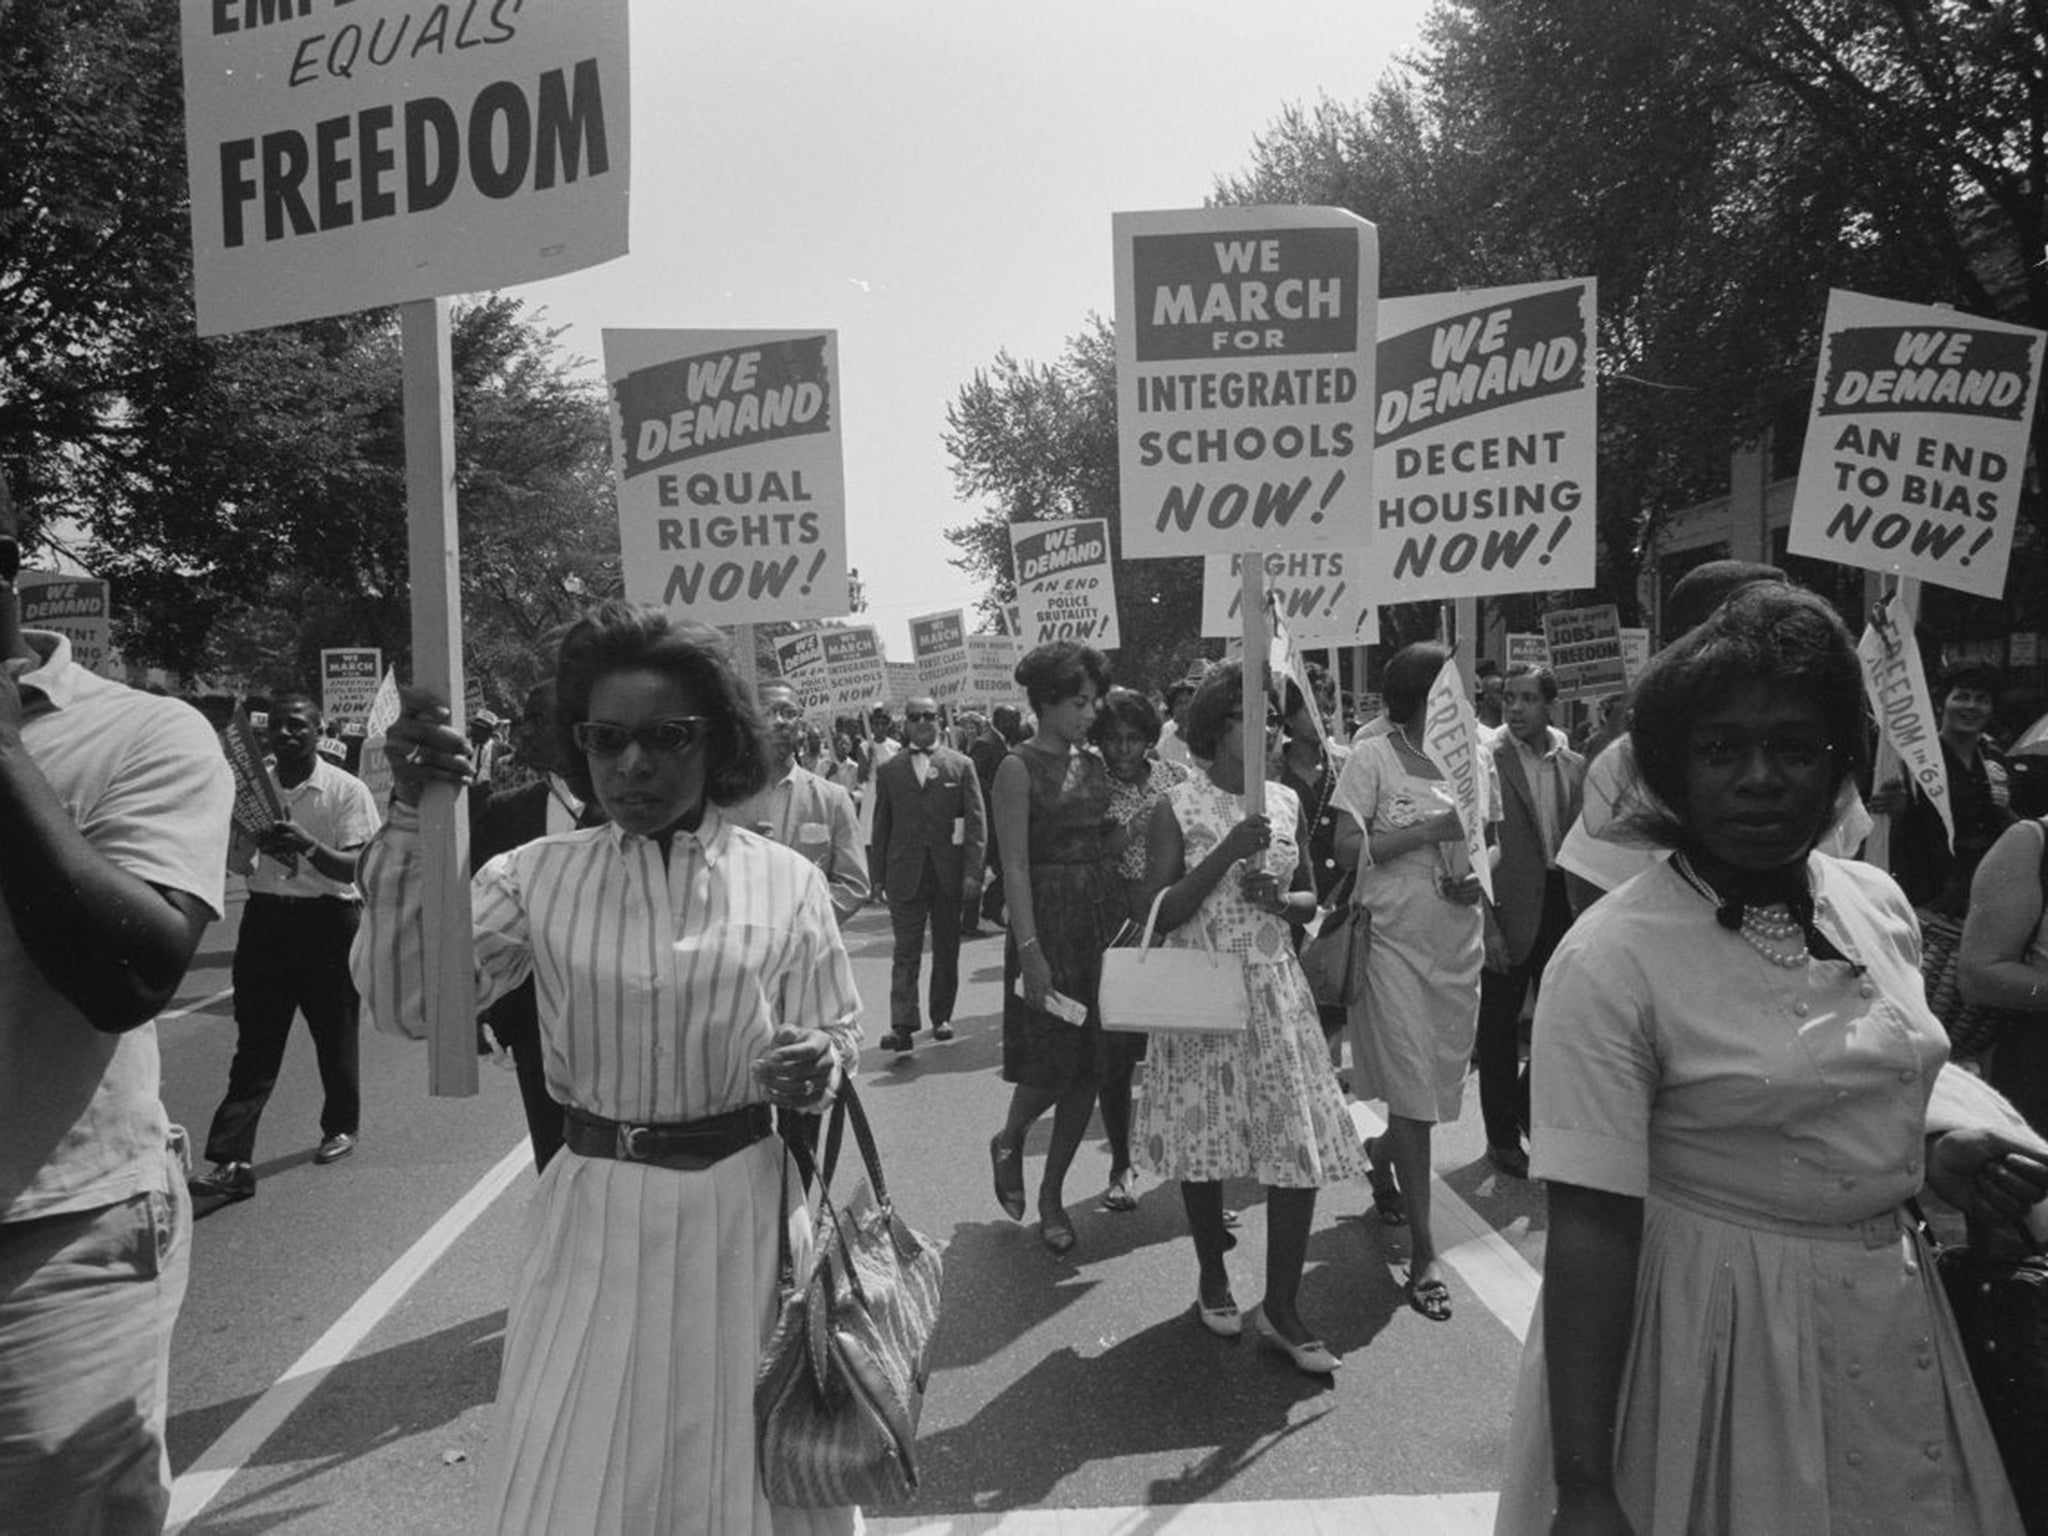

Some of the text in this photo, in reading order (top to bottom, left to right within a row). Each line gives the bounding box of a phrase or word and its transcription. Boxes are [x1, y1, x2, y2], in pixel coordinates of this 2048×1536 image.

[289, 0, 521, 87] EQUALS
[219, 57, 609, 249] FREEDOM
[1214, 240, 1280, 274] WE
[1152, 277, 1341, 326] MARCH
[1212, 329, 1285, 350] FOR
[1430, 308, 1512, 370] WE
[1894, 331, 1973, 366] WE
[687, 351, 761, 403] WE
[1137, 367, 1358, 413] INTEGRATED
[1375, 336, 1577, 435] DEMAND
[1834, 368, 2022, 407] DEMAND
[637, 382, 823, 462] DEMAND
[1139, 422, 1354, 467] SCHOOLS
[1396, 431, 1566, 479] DECENT
[1834, 424, 2008, 483] AN END
[657, 471, 812, 507] EQUAL
[1155, 468, 1346, 533] NOW!
[1379, 480, 1582, 529] HOUSING
[1834, 461, 1999, 522] TO BIAS
[657, 512, 819, 550] RIGHTS
[1045, 528, 1077, 551] WE
[1393, 515, 1572, 580] NOW!
[1826, 503, 1994, 566] NOW!
[662, 548, 827, 606] NOW!
[1023, 540, 1103, 579] DEMAND
[46, 584, 79, 600] WE
[1031, 577, 1099, 593] AN END
[1048, 595, 1089, 609] POLICE
[26, 597, 101, 619] DEMAND
[1036, 608, 1099, 623] BRUTALITY
[919, 627, 959, 646] MARCH
[1038, 614, 1110, 644] NOW!
[1551, 625, 1594, 645] JOBS
[827, 640, 872, 656] MARCH
[943, 650, 966, 664] CLASS
[1553, 642, 1618, 666] FREEDOM
[329, 662, 373, 672] MARCH
[830, 672, 882, 688] SCHOOLS
[839, 681, 883, 702] NOW!
[930, 676, 967, 697] NOW!
[330, 701, 375, 714] NOW!
[1426, 686, 1476, 810] FREEDOM
